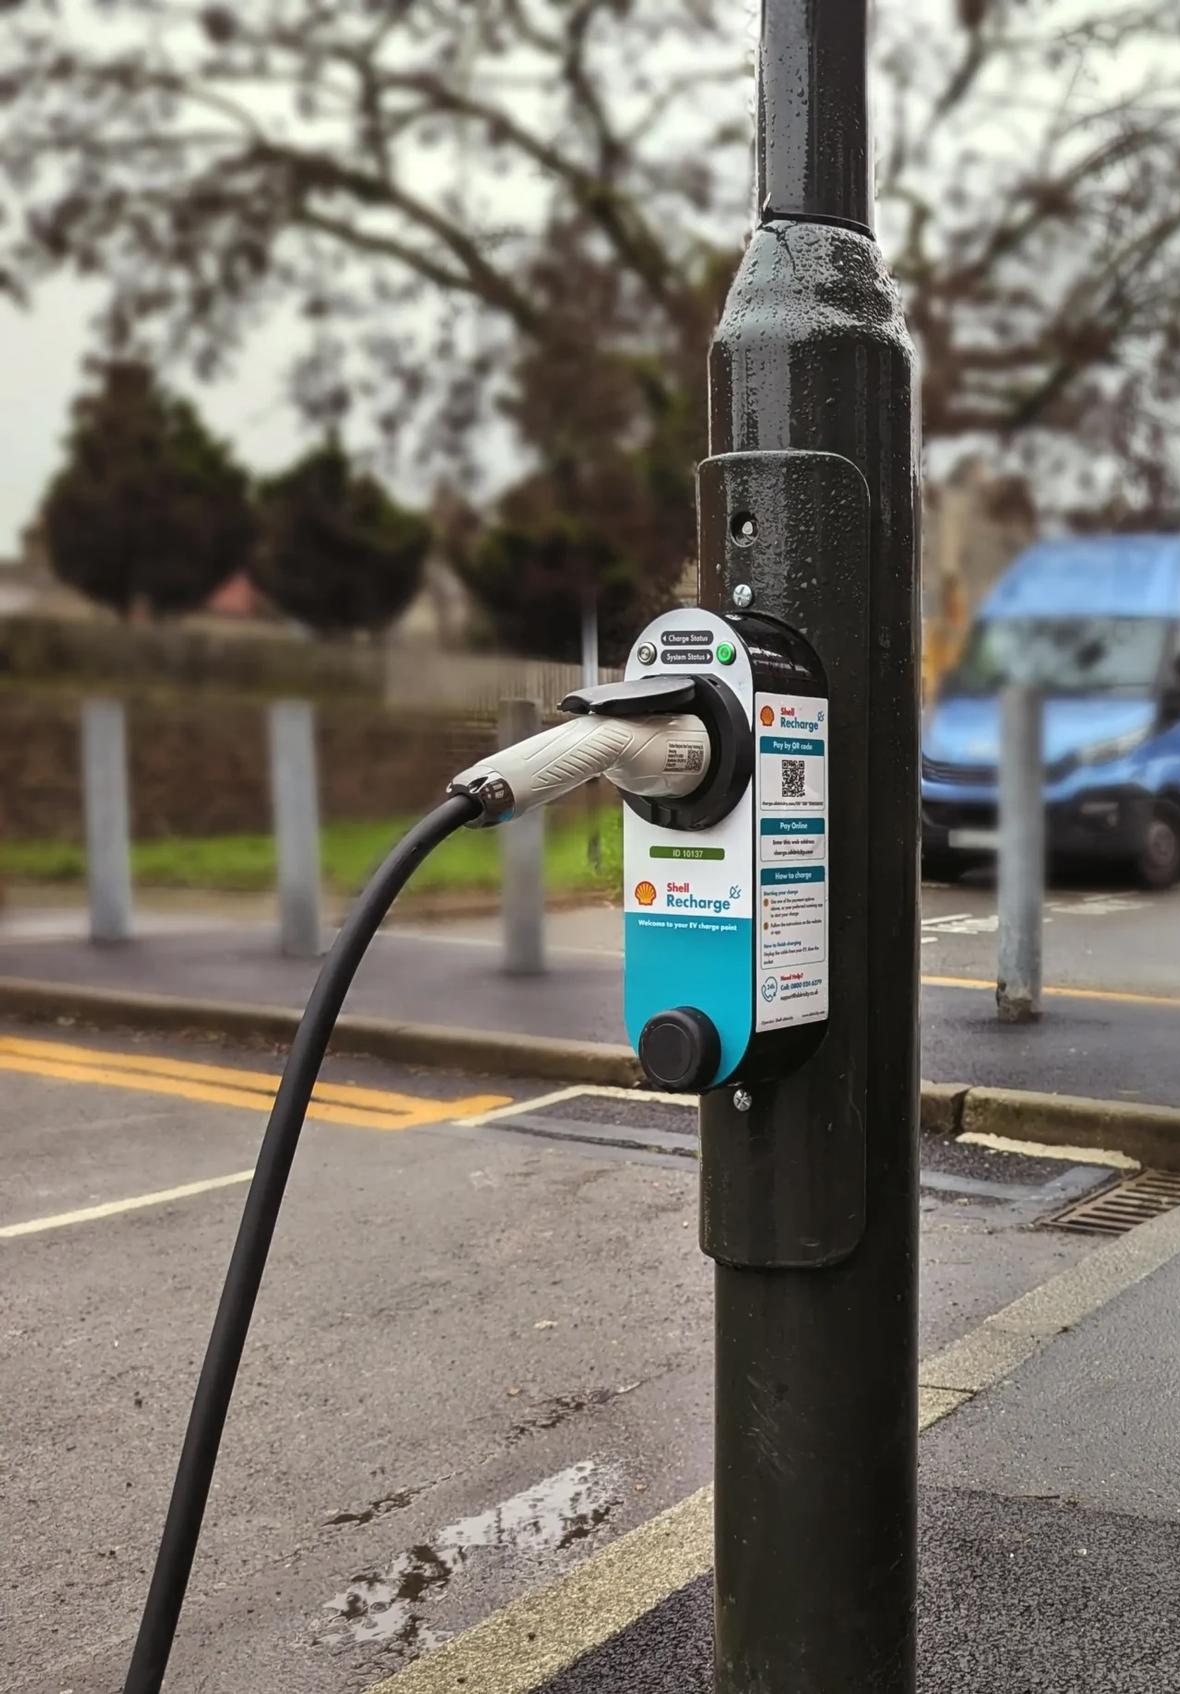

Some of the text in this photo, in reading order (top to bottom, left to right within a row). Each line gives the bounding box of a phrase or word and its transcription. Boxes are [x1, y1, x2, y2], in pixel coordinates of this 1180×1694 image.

[668, 634, 689, 643] Charge
[666, 654, 686, 662] System
[780, 707, 795, 716] Shell
[780, 717, 819, 732] Recharge
[773, 741, 783, 750] Pay
[785, 742, 791, 750] by
[792, 742, 800, 751] QR
[780, 822, 791, 831] Pay
[683, 850, 703, 858] 10137
[795, 871, 812, 880] charge
[667, 882, 690, 893] Shell
[667, 894, 730, 913] Recharge
[698, 922, 719, 931] charge
